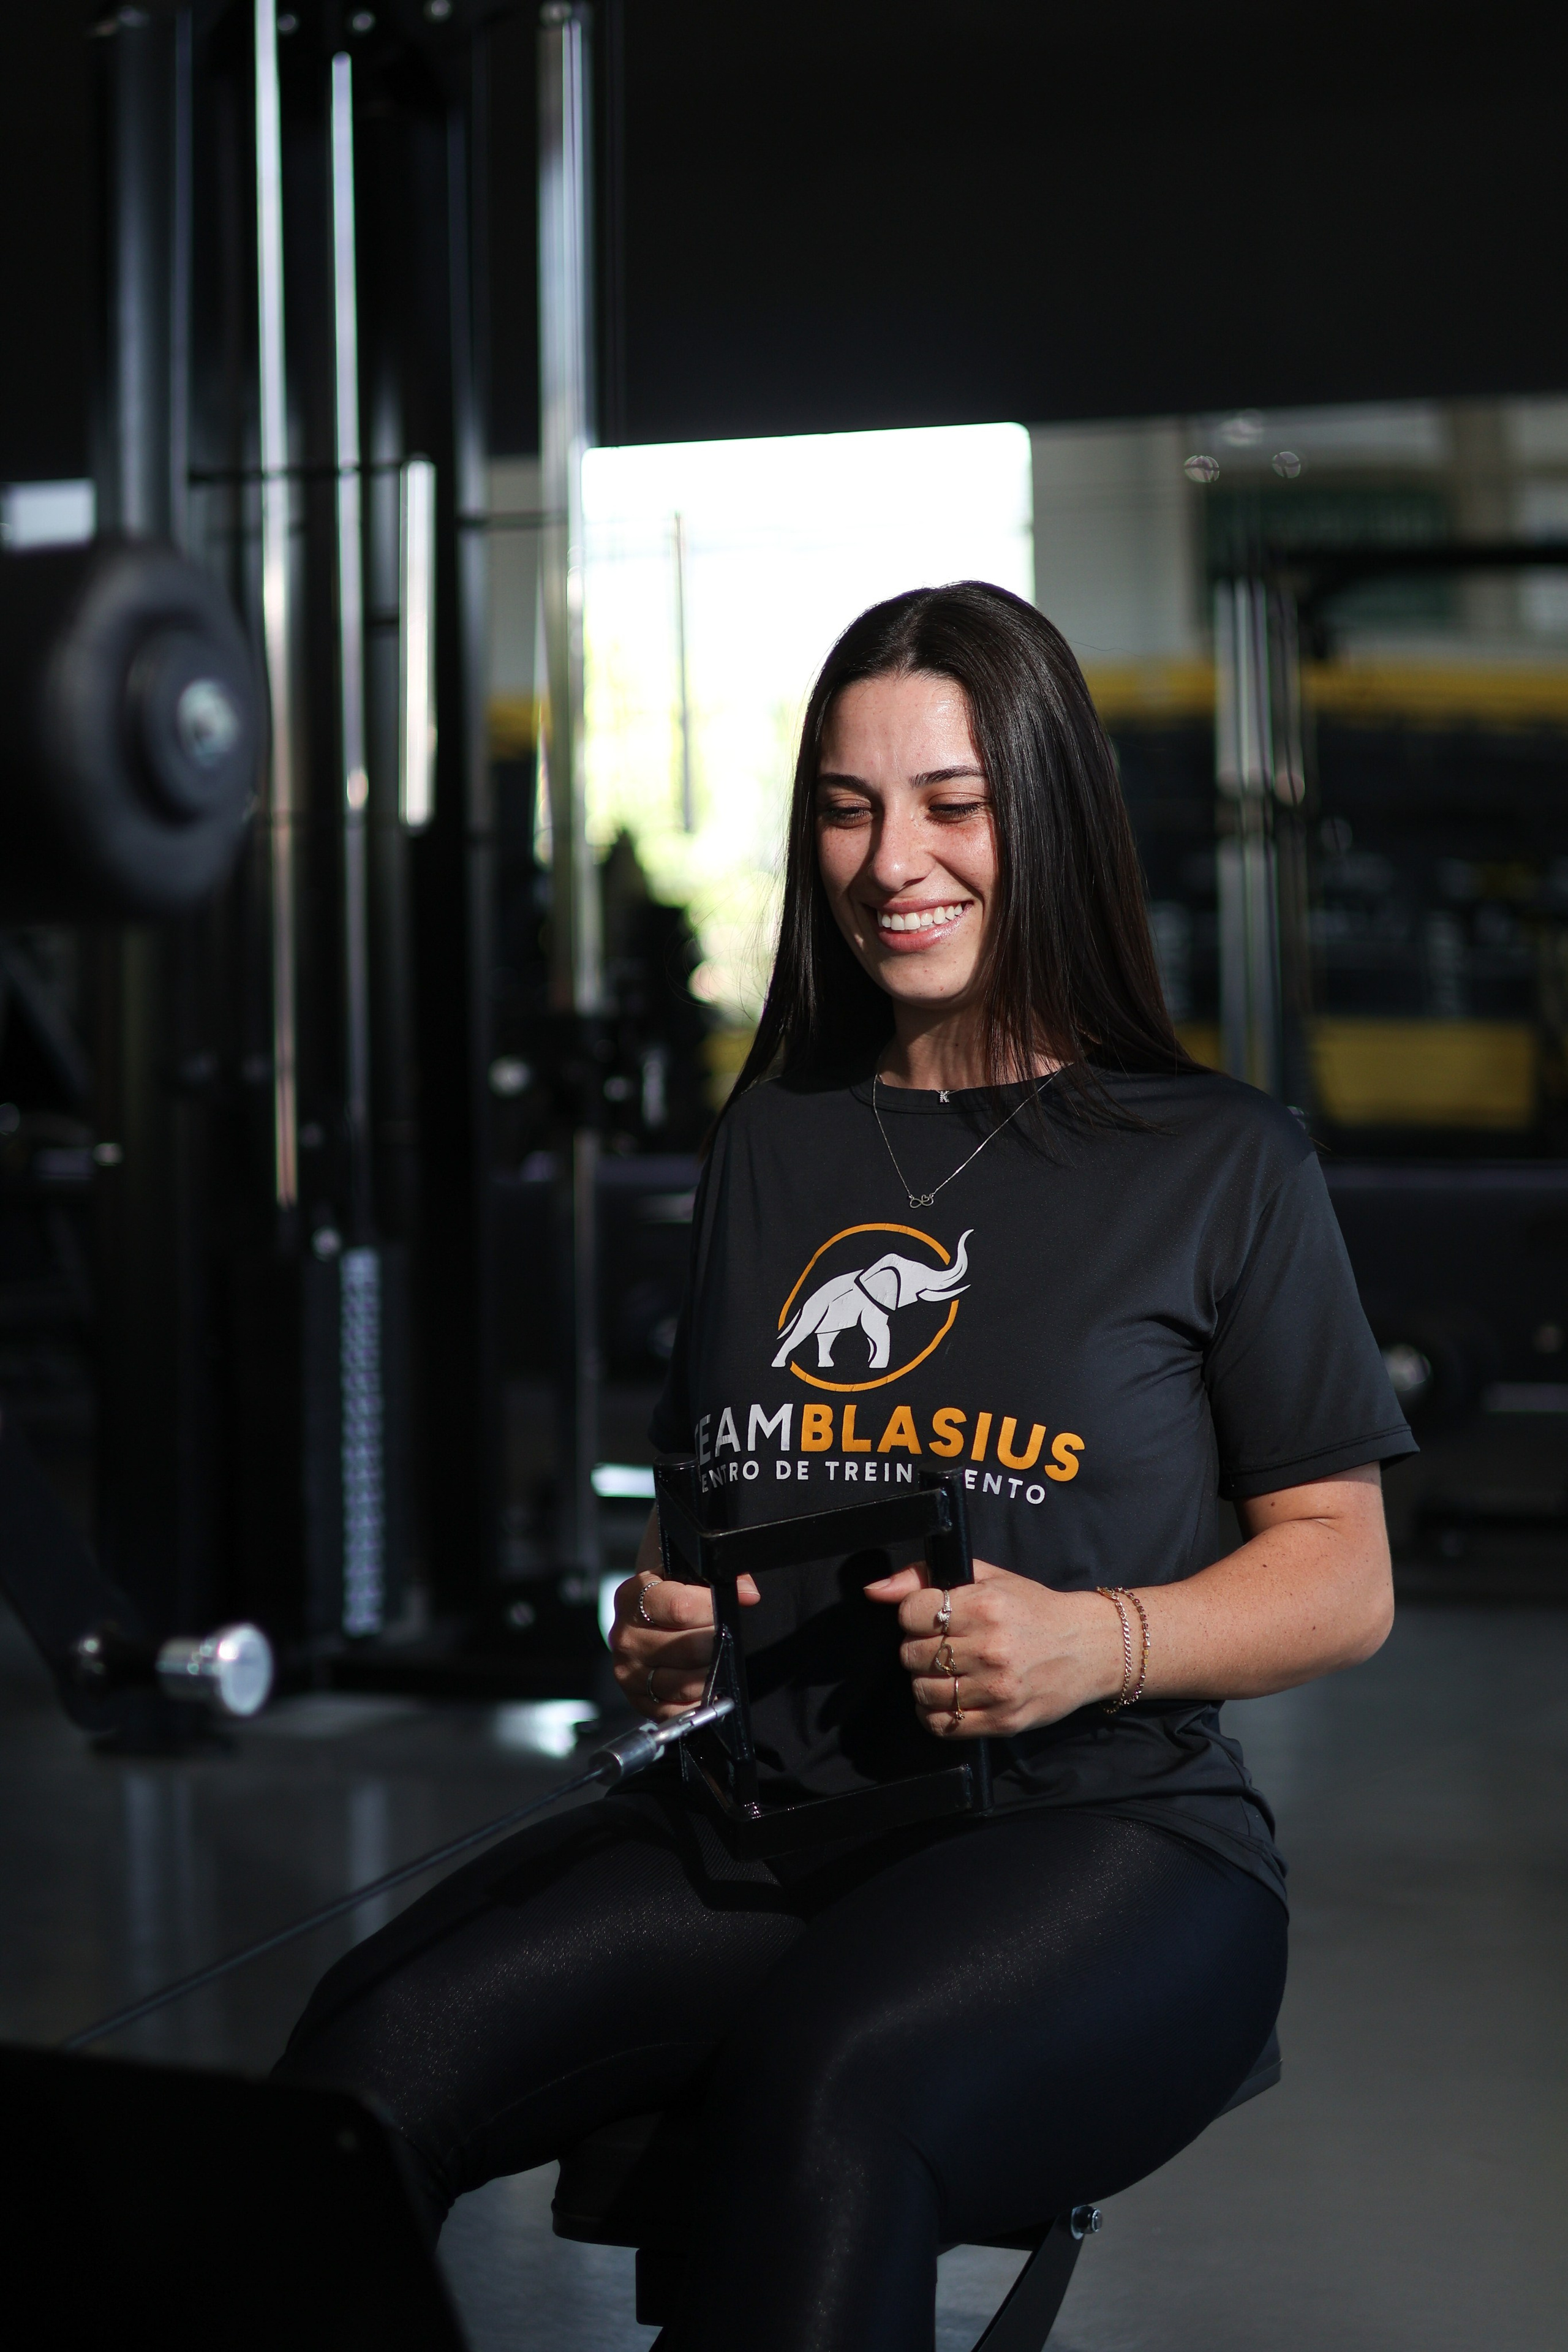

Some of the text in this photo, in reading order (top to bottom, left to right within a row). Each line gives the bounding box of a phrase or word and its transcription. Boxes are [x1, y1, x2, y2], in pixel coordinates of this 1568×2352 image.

[939, 1090, 950, 1102] K
[698, 1460, 1046, 1505] ENTRO DE TREINENTO
